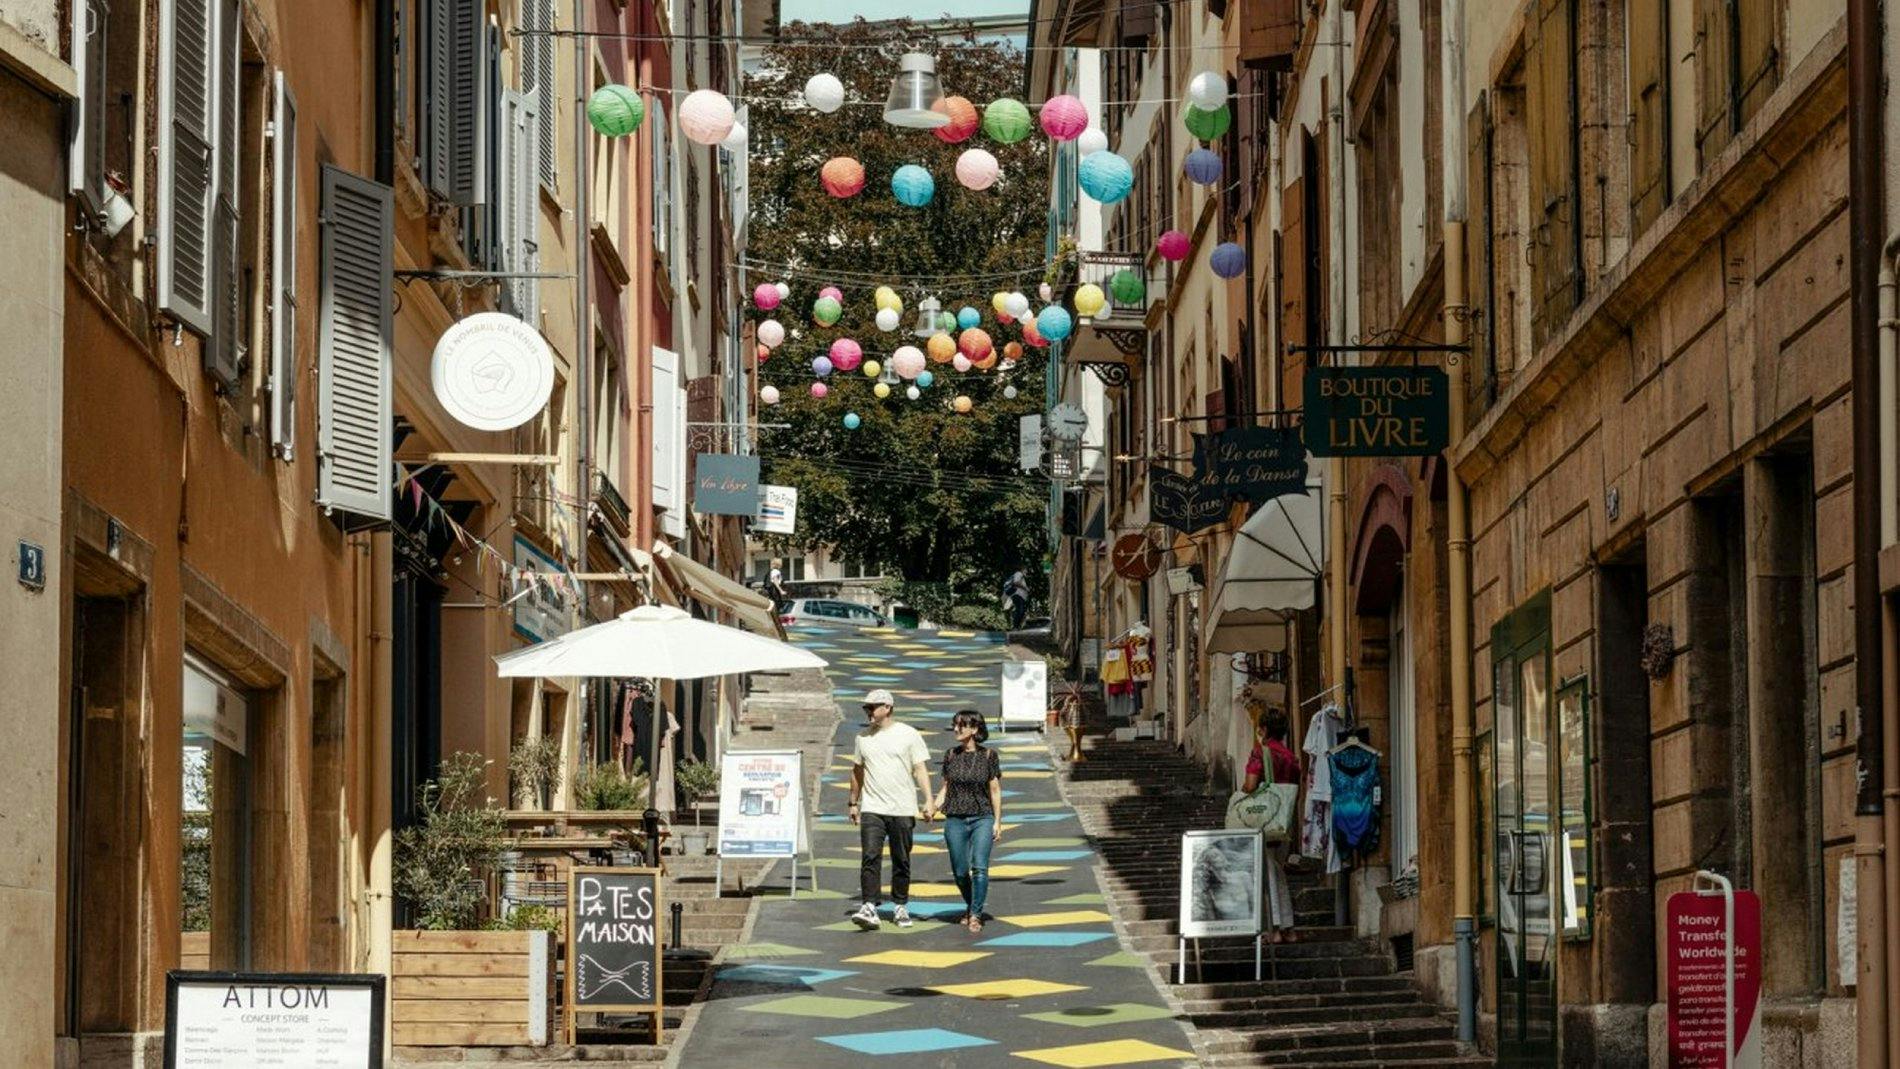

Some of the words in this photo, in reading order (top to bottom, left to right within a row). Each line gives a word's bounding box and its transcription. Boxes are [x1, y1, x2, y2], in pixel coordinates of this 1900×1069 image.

[453, 323, 495, 345] NOMBRIL
[497, 322, 510, 334] DE
[1320, 377, 1433, 399] BOUTIQUE
[1361, 398, 1392, 416] DU
[1329, 417, 1429, 448] LIVRE
[1221, 441, 1243, 462] Le
[1246, 447, 1280, 460] coin
[1201, 470, 1220, 486] de
[1224, 469, 1240, 484] la
[1247, 465, 1300, 483] Danse
[28, 549, 37, 579] 3
[1678, 914, 1720, 927] Money
[577, 921, 654, 946] MAISON
[1678, 929, 1726, 942] Transfe
[1678, 945, 1747, 959] Worldwde
[223, 985, 329, 1009] ATTOM
[240, 1014, 280, 1024] CONCEPT
[282, 1014, 310, 1024] STORE
